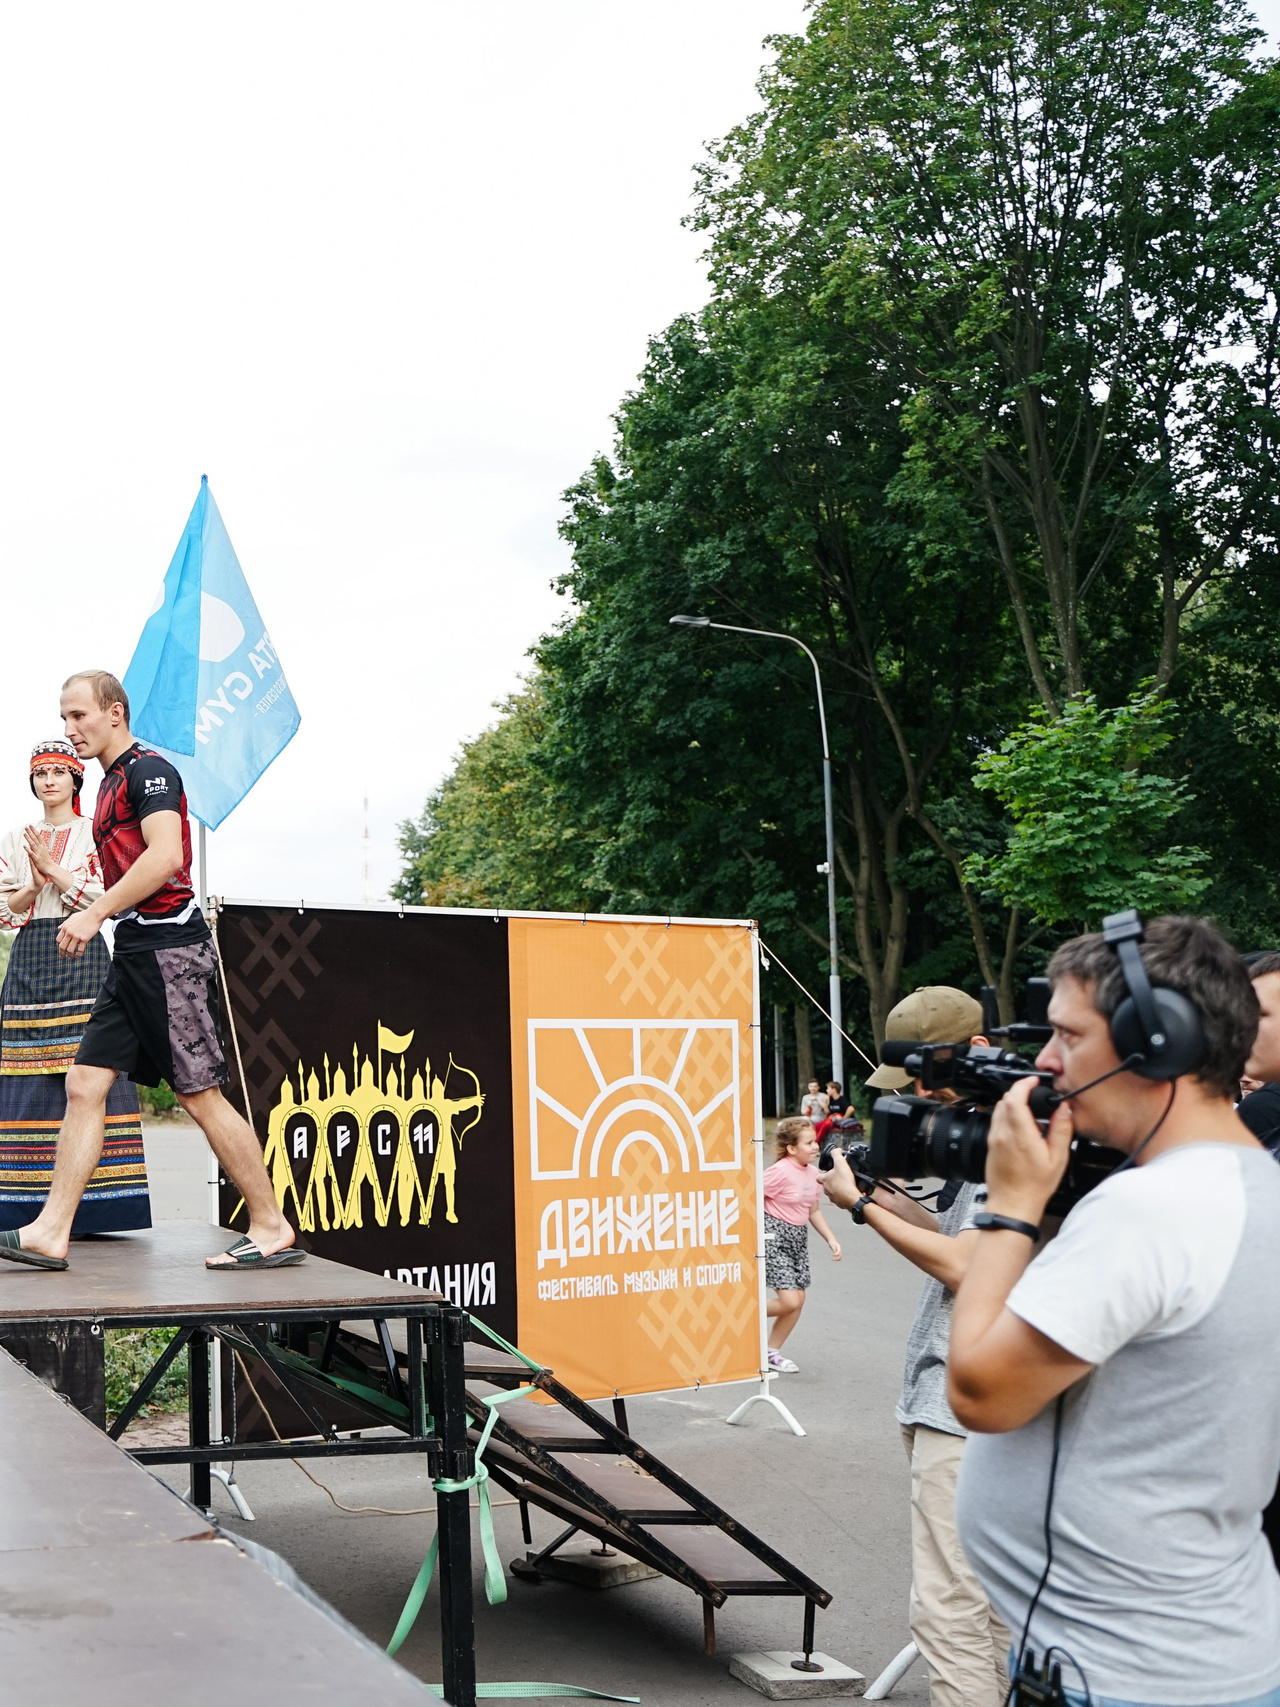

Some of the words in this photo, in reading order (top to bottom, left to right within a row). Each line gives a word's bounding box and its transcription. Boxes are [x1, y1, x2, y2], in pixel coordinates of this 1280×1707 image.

[144, 786, 169, 795] SPORT
[537, 1188, 740, 1271] ДВИЖЕНИЕ
[383, 1261, 496, 1307] ТАНИЯ
[538, 1274, 618, 1301] ФЕСТИВАЛЬ
[624, 1268, 678, 1294] МУЗЫКИ
[683, 1266, 691, 1287] И
[695, 1262, 741, 1286] СПОРТА
